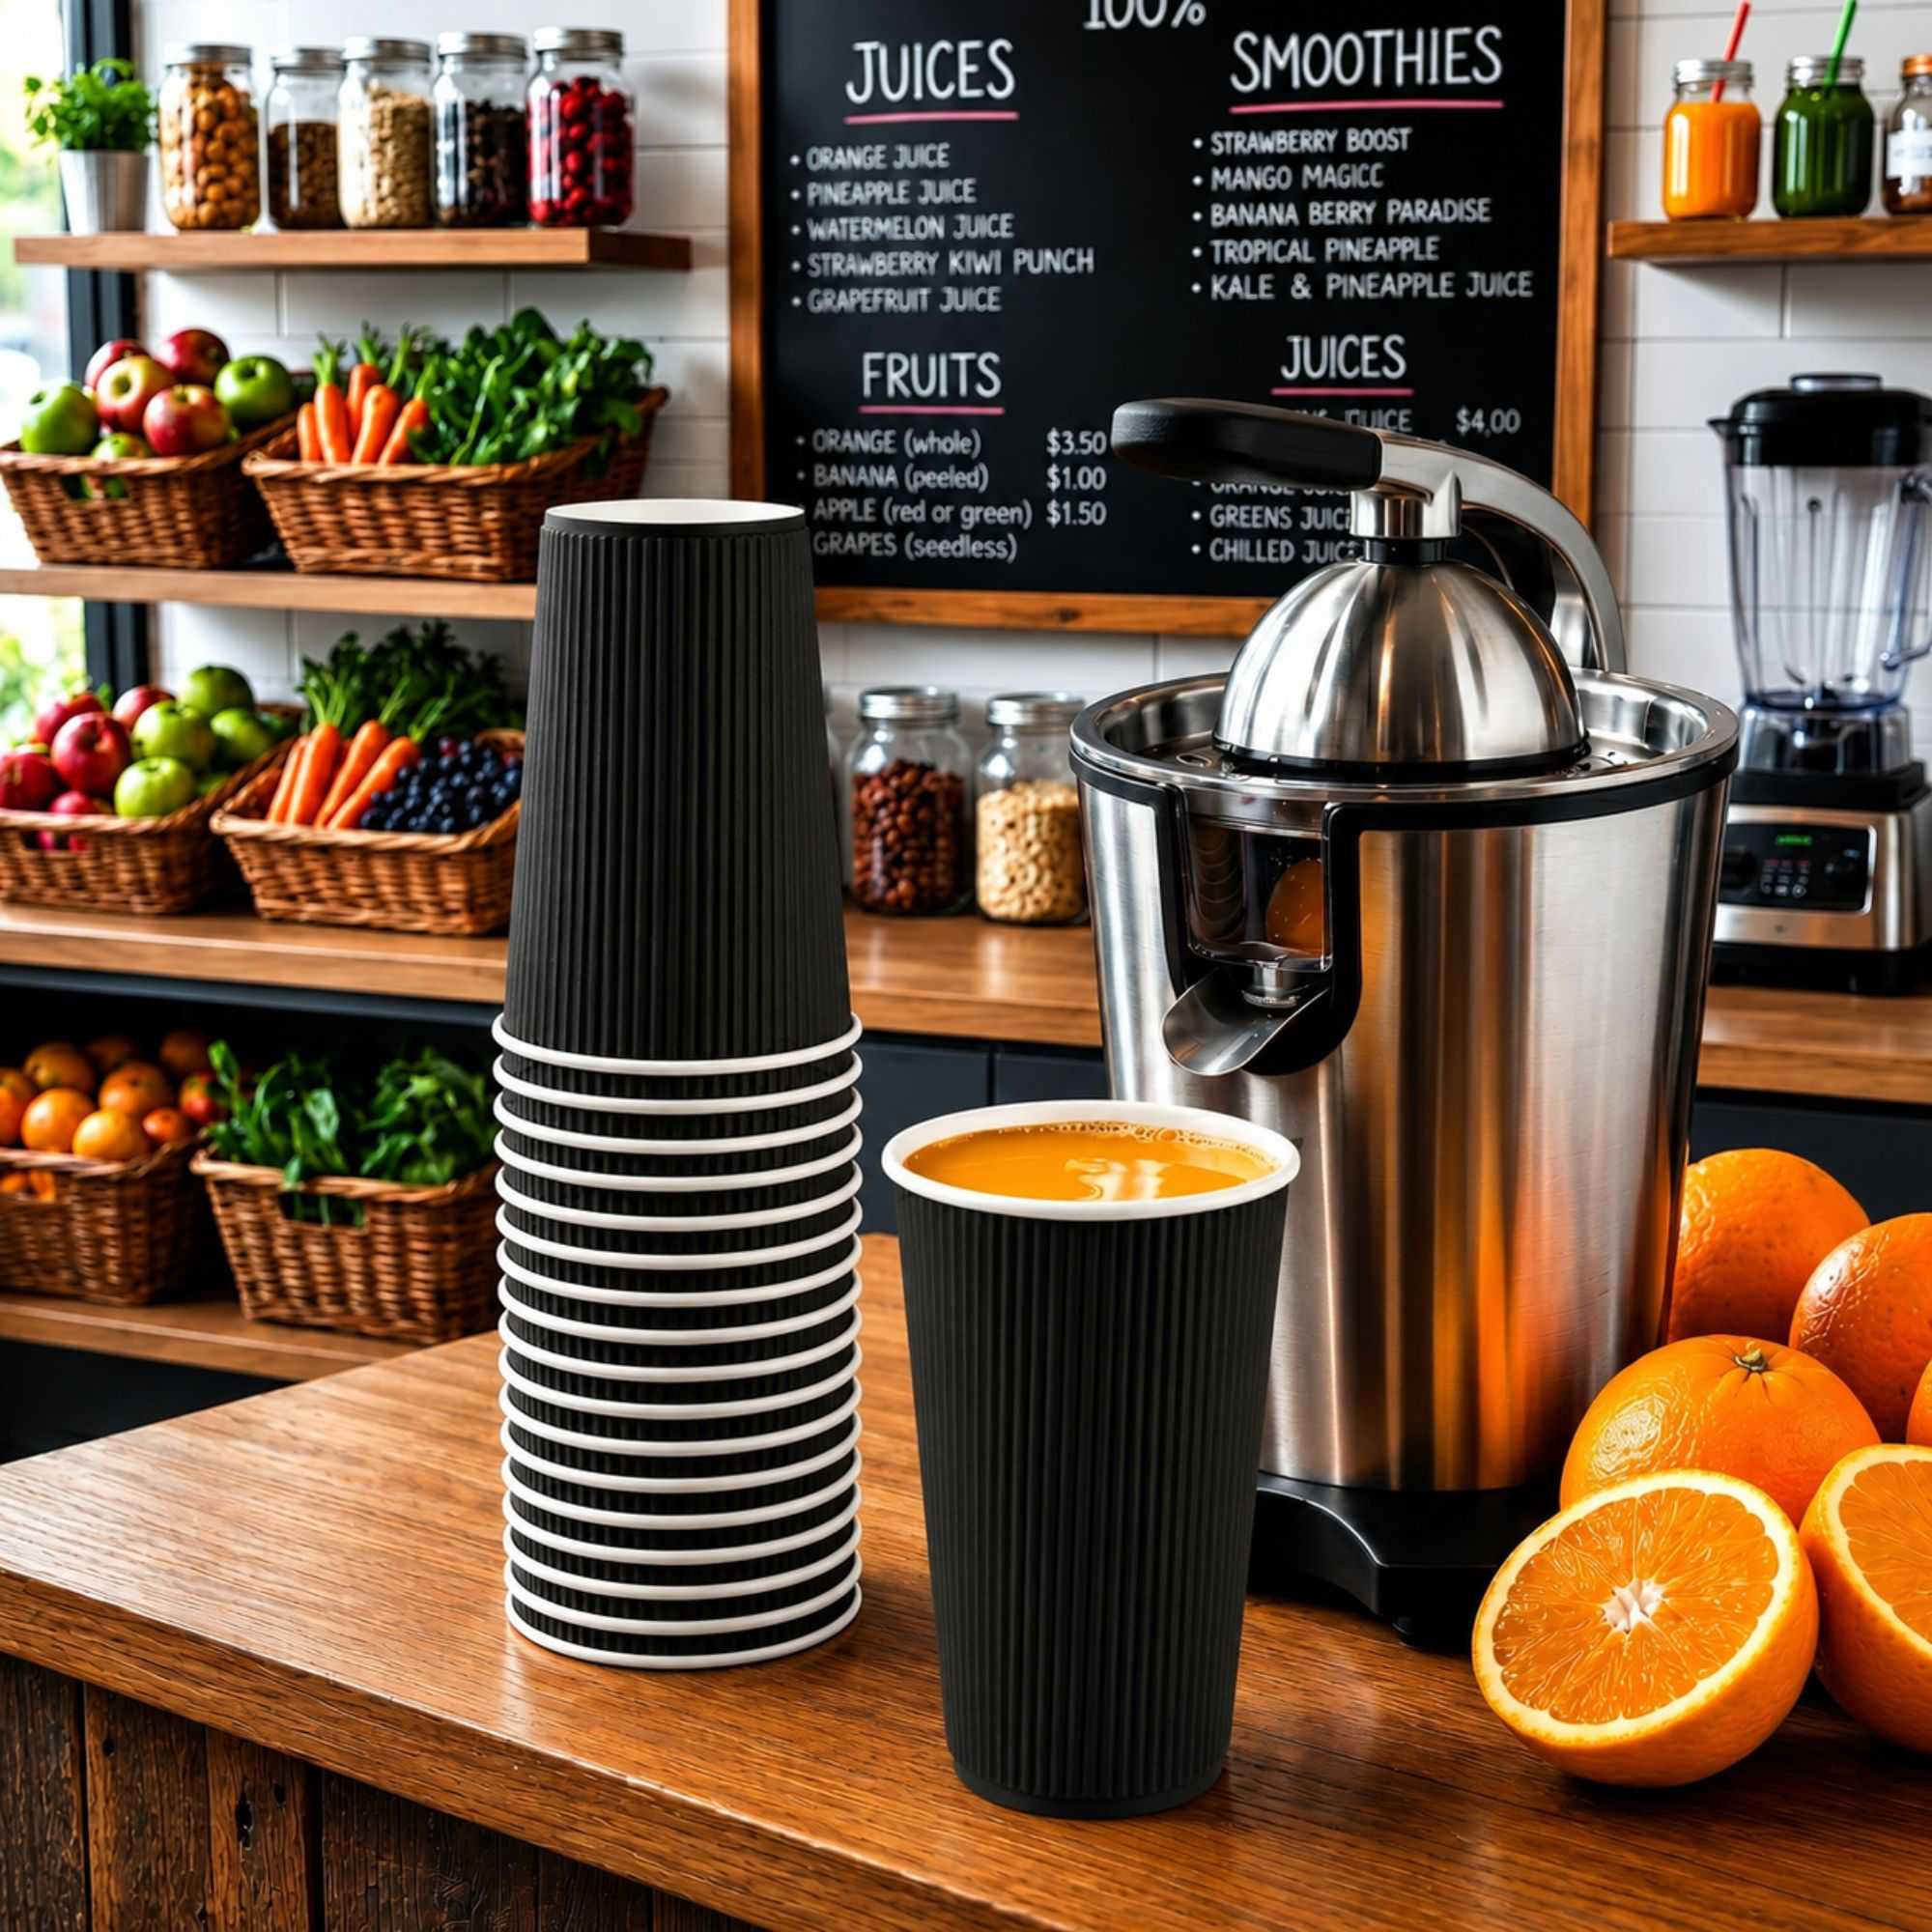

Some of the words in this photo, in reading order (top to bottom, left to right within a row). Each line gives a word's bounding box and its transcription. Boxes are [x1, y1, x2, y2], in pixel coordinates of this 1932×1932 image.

[846, 39, 1015, 103] JUICES
[1230, 25, 1502, 93] SMOOTHIES
[807, 144, 887, 171] ORANGE
[892, 142, 951, 170] JUICE
[1210, 128, 1338, 156] STRAWBERRY
[1346, 127, 1412, 153] BOOST
[1210, 165, 1293, 191] MANGO
[1301, 162, 1383, 189] MAGICC
[808, 180, 910, 207] PINEAPPLE
[917, 178, 977, 205] JUICE
[808, 214, 945, 242] WATERMELON
[952, 213, 1014, 241] JUICE
[1210, 202, 1299, 228] BANANA
[1308, 200, 1377, 226] BERRY
[1386, 197, 1492, 224] PARADISE
[808, 250, 940, 277] STRAWBERRY
[949, 249, 1002, 275] KIWI
[1012, 247, 1095, 275] PUNCH
[1209, 238, 1316, 265] TROPICAL
[1324, 236, 1440, 263] PINEAPPLE
[808, 288, 930, 314] GRAPEFRUIT
[939, 286, 1002, 313] JUICE
[1210, 273, 1275, 300] KALE
[1290, 272, 1312, 299] &
[1326, 271, 1455, 299] PINEAPPLE
[1465, 270, 1533, 298] JUICE
[1280, 333, 1406, 381] JUICES
[862, 352, 1002, 398] FRUITS
[812, 429, 897, 454] ORANGE
[903, 428, 981, 459] (whole)
[1046, 427, 1107, 457] $3.50
[812, 464, 899, 489] BANANA
[904, 463, 989, 494] (peeled)
[1046, 463, 1107, 493] $1.00
[812, 497, 877, 523] APPLE
[883, 497, 926, 526] (red
[931, 504, 954, 524] or
[961, 498, 1033, 530] green)
[1046, 498, 1107, 527] $1.50
[1209, 503, 1293, 530] GREENS
[812, 531, 897, 557] GRAPES
[904, 531, 1018, 563] (seedless)
[1208, 537, 1295, 563] CHILLED
